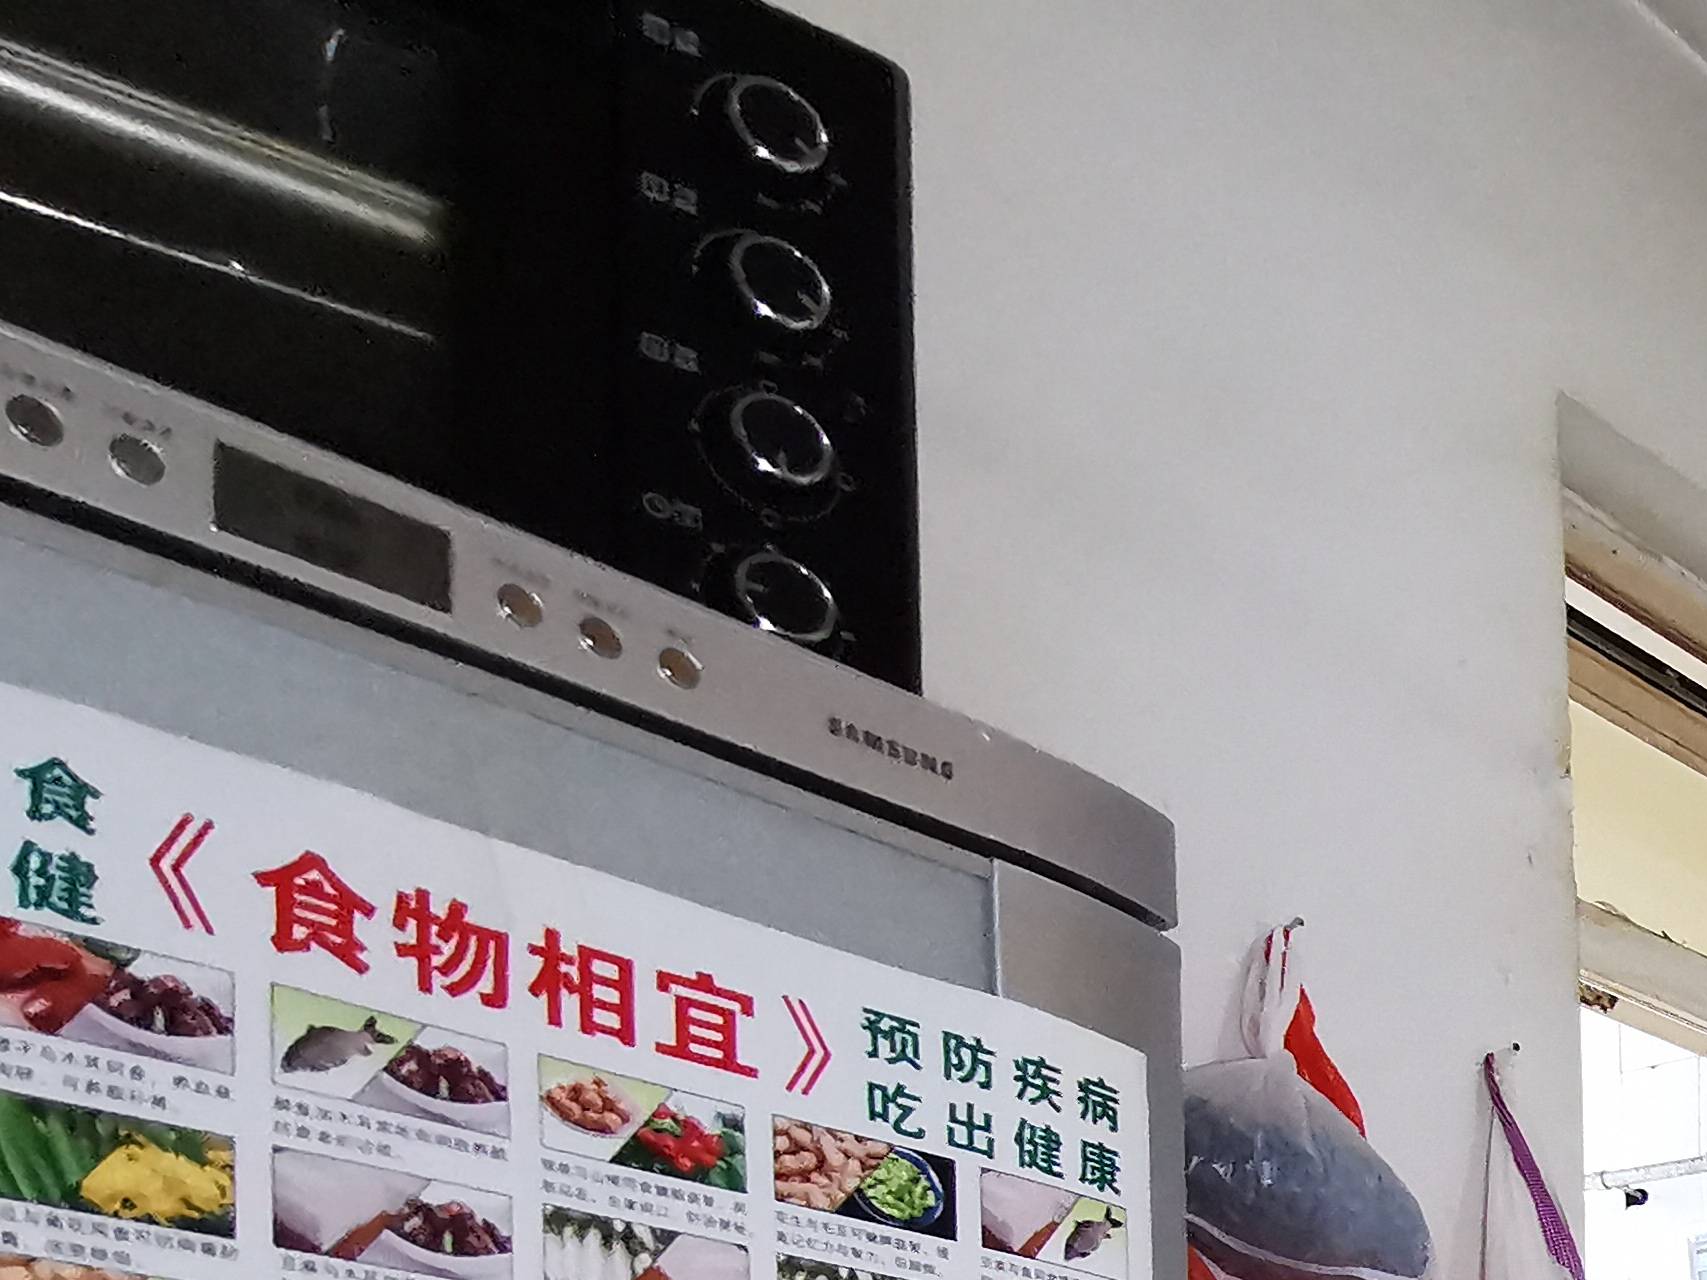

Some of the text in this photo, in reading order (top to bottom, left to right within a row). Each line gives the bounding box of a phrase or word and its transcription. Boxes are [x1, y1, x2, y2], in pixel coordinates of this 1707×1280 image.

[827, 716, 954, 782] SAMSUNG
[13, 756, 104, 836] 食
[10, 840, 104, 926] 健
[861, 1006, 1120, 1133] 预防疾病
[866, 1080, 1122, 1197] 吃出健康
